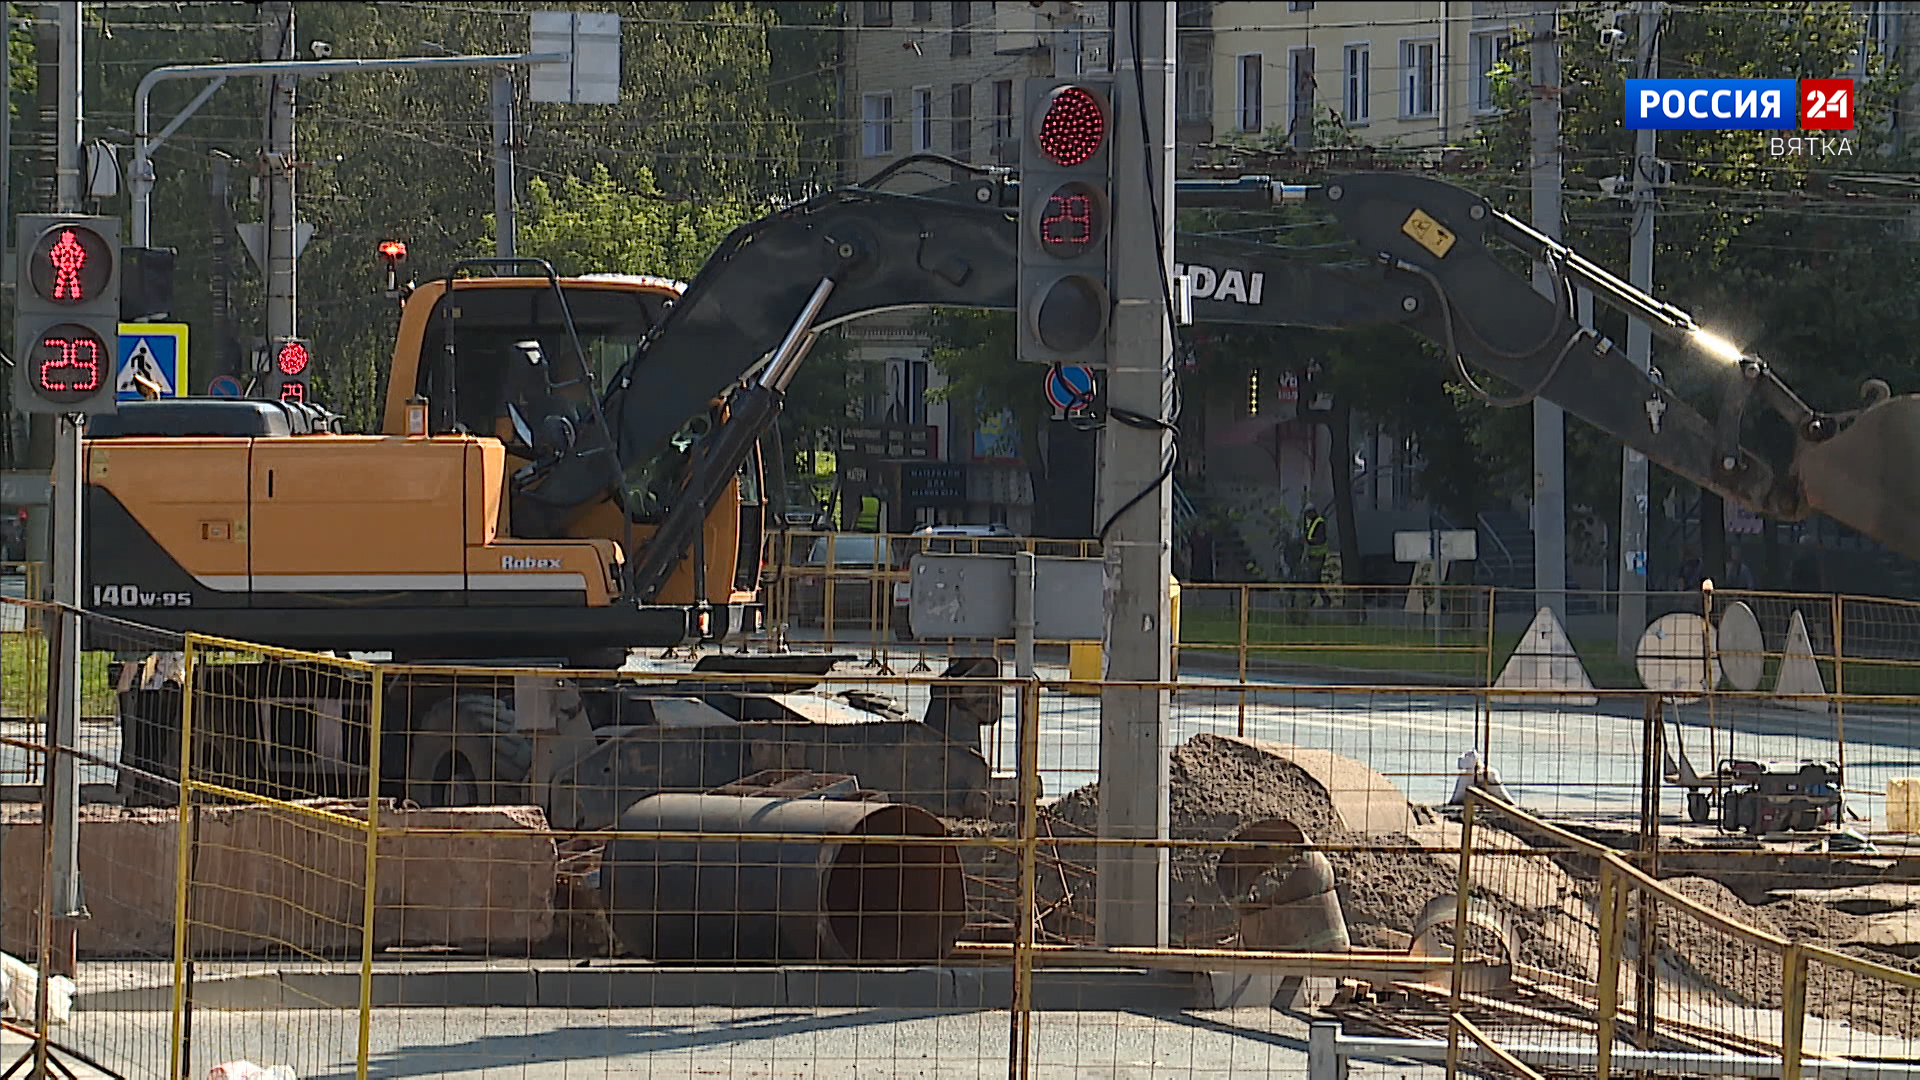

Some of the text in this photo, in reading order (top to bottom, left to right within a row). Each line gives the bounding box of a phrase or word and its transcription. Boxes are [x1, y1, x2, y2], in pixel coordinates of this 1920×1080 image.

[1043, 195, 1090, 243] 29
[42, 339, 97, 390] 29
[501, 555, 562, 570] Robex
